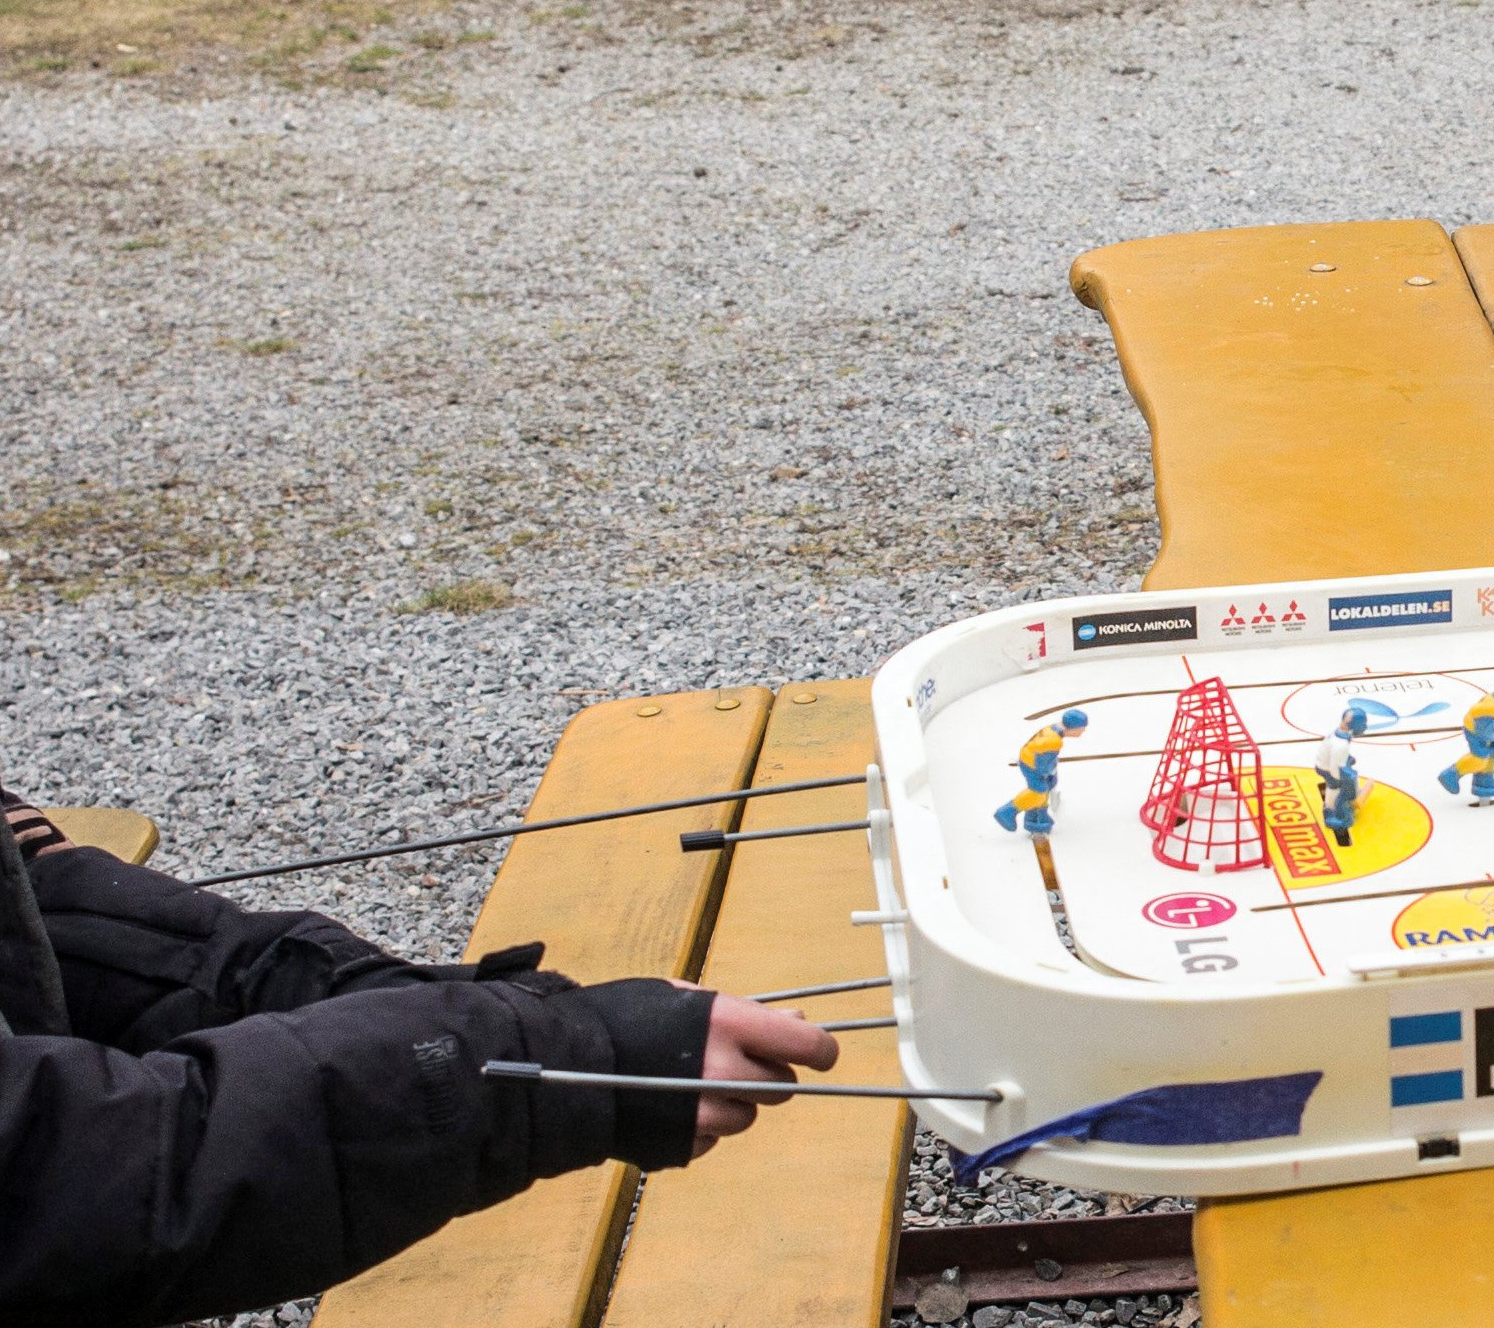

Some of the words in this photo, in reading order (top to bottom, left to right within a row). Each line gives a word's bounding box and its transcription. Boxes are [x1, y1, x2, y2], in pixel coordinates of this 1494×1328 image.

[1330, 600, 1451, 621] LOKALDELEN.SE
[1099, 622, 1143, 636] KONICA
[1144, 617, 1192, 632] MINOLTA
[1334, 679, 1435, 696] telenor
[1174, 936, 1239, 974] LG
